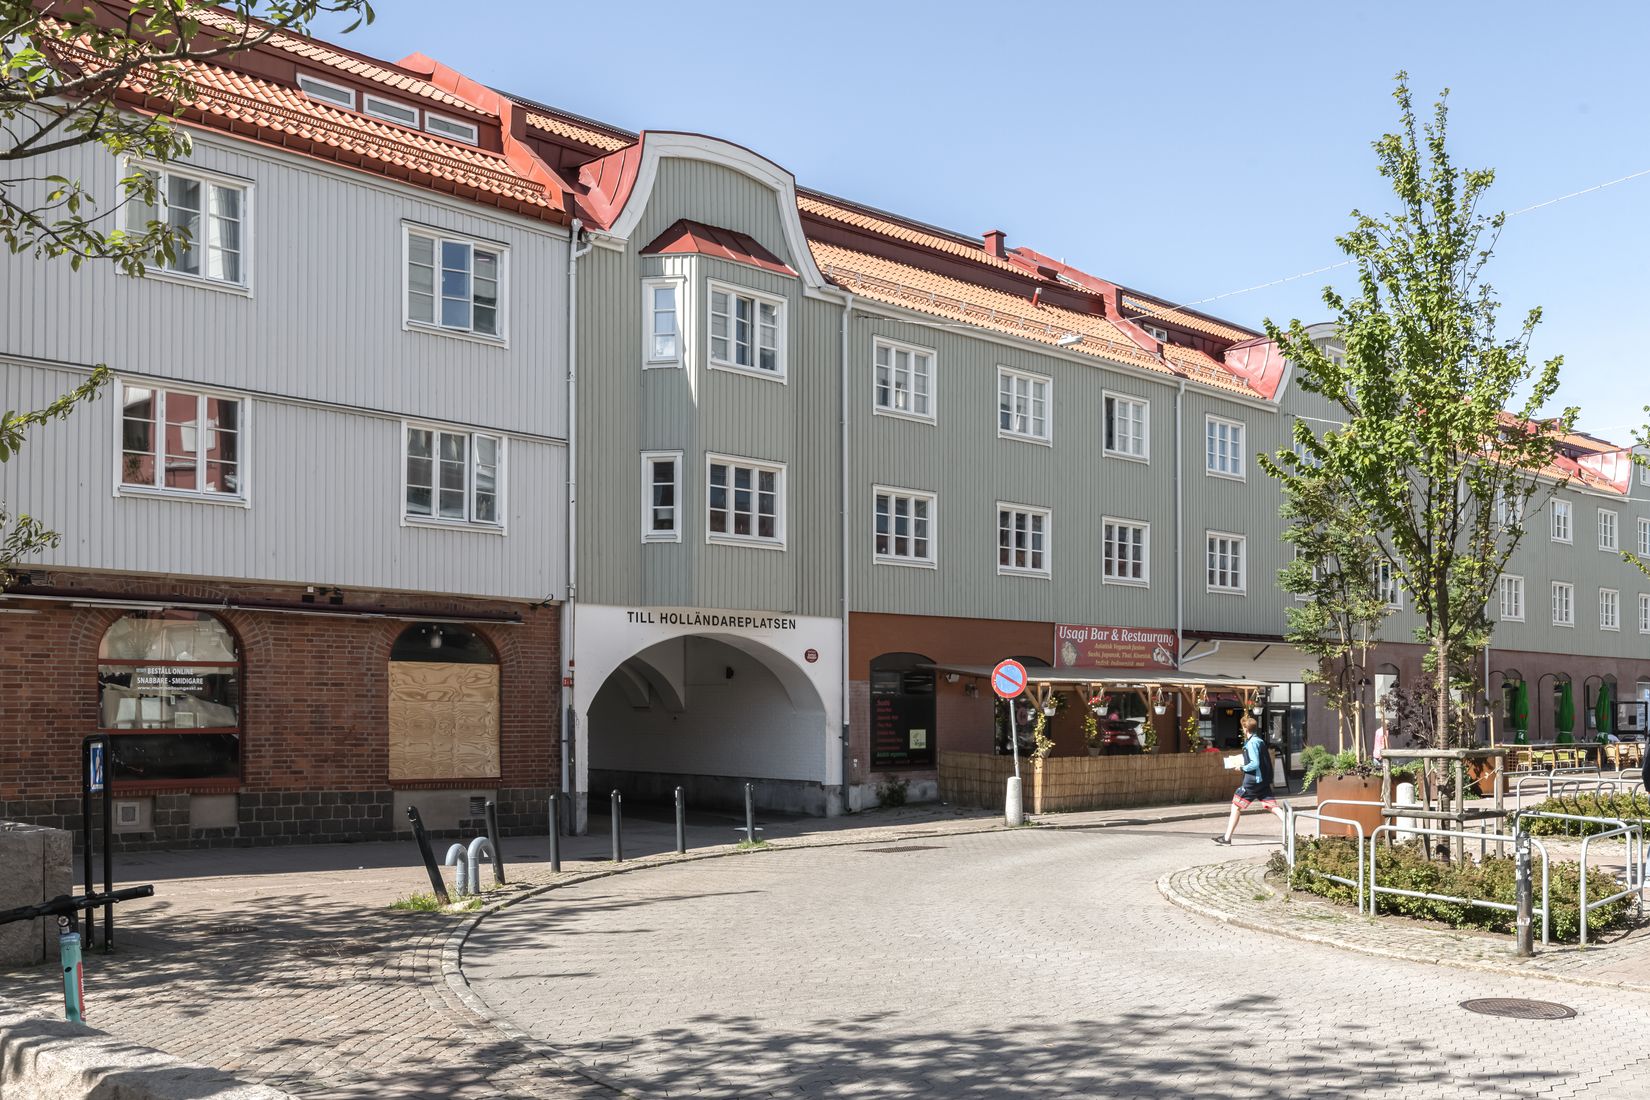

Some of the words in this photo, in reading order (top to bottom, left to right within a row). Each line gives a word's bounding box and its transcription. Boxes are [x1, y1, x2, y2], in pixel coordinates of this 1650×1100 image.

[627, 611, 655, 624] TILL
[660, 611, 796, 630] HOLLÄNDAREPLATSEN
[1059, 625, 1088, 643] Usagi
[1091, 627, 1109, 640] Bar
[1111, 629, 1119, 641] &
[1121, 629, 1174, 646] Restaurang
[147, 667, 171, 675] BESTÄLL
